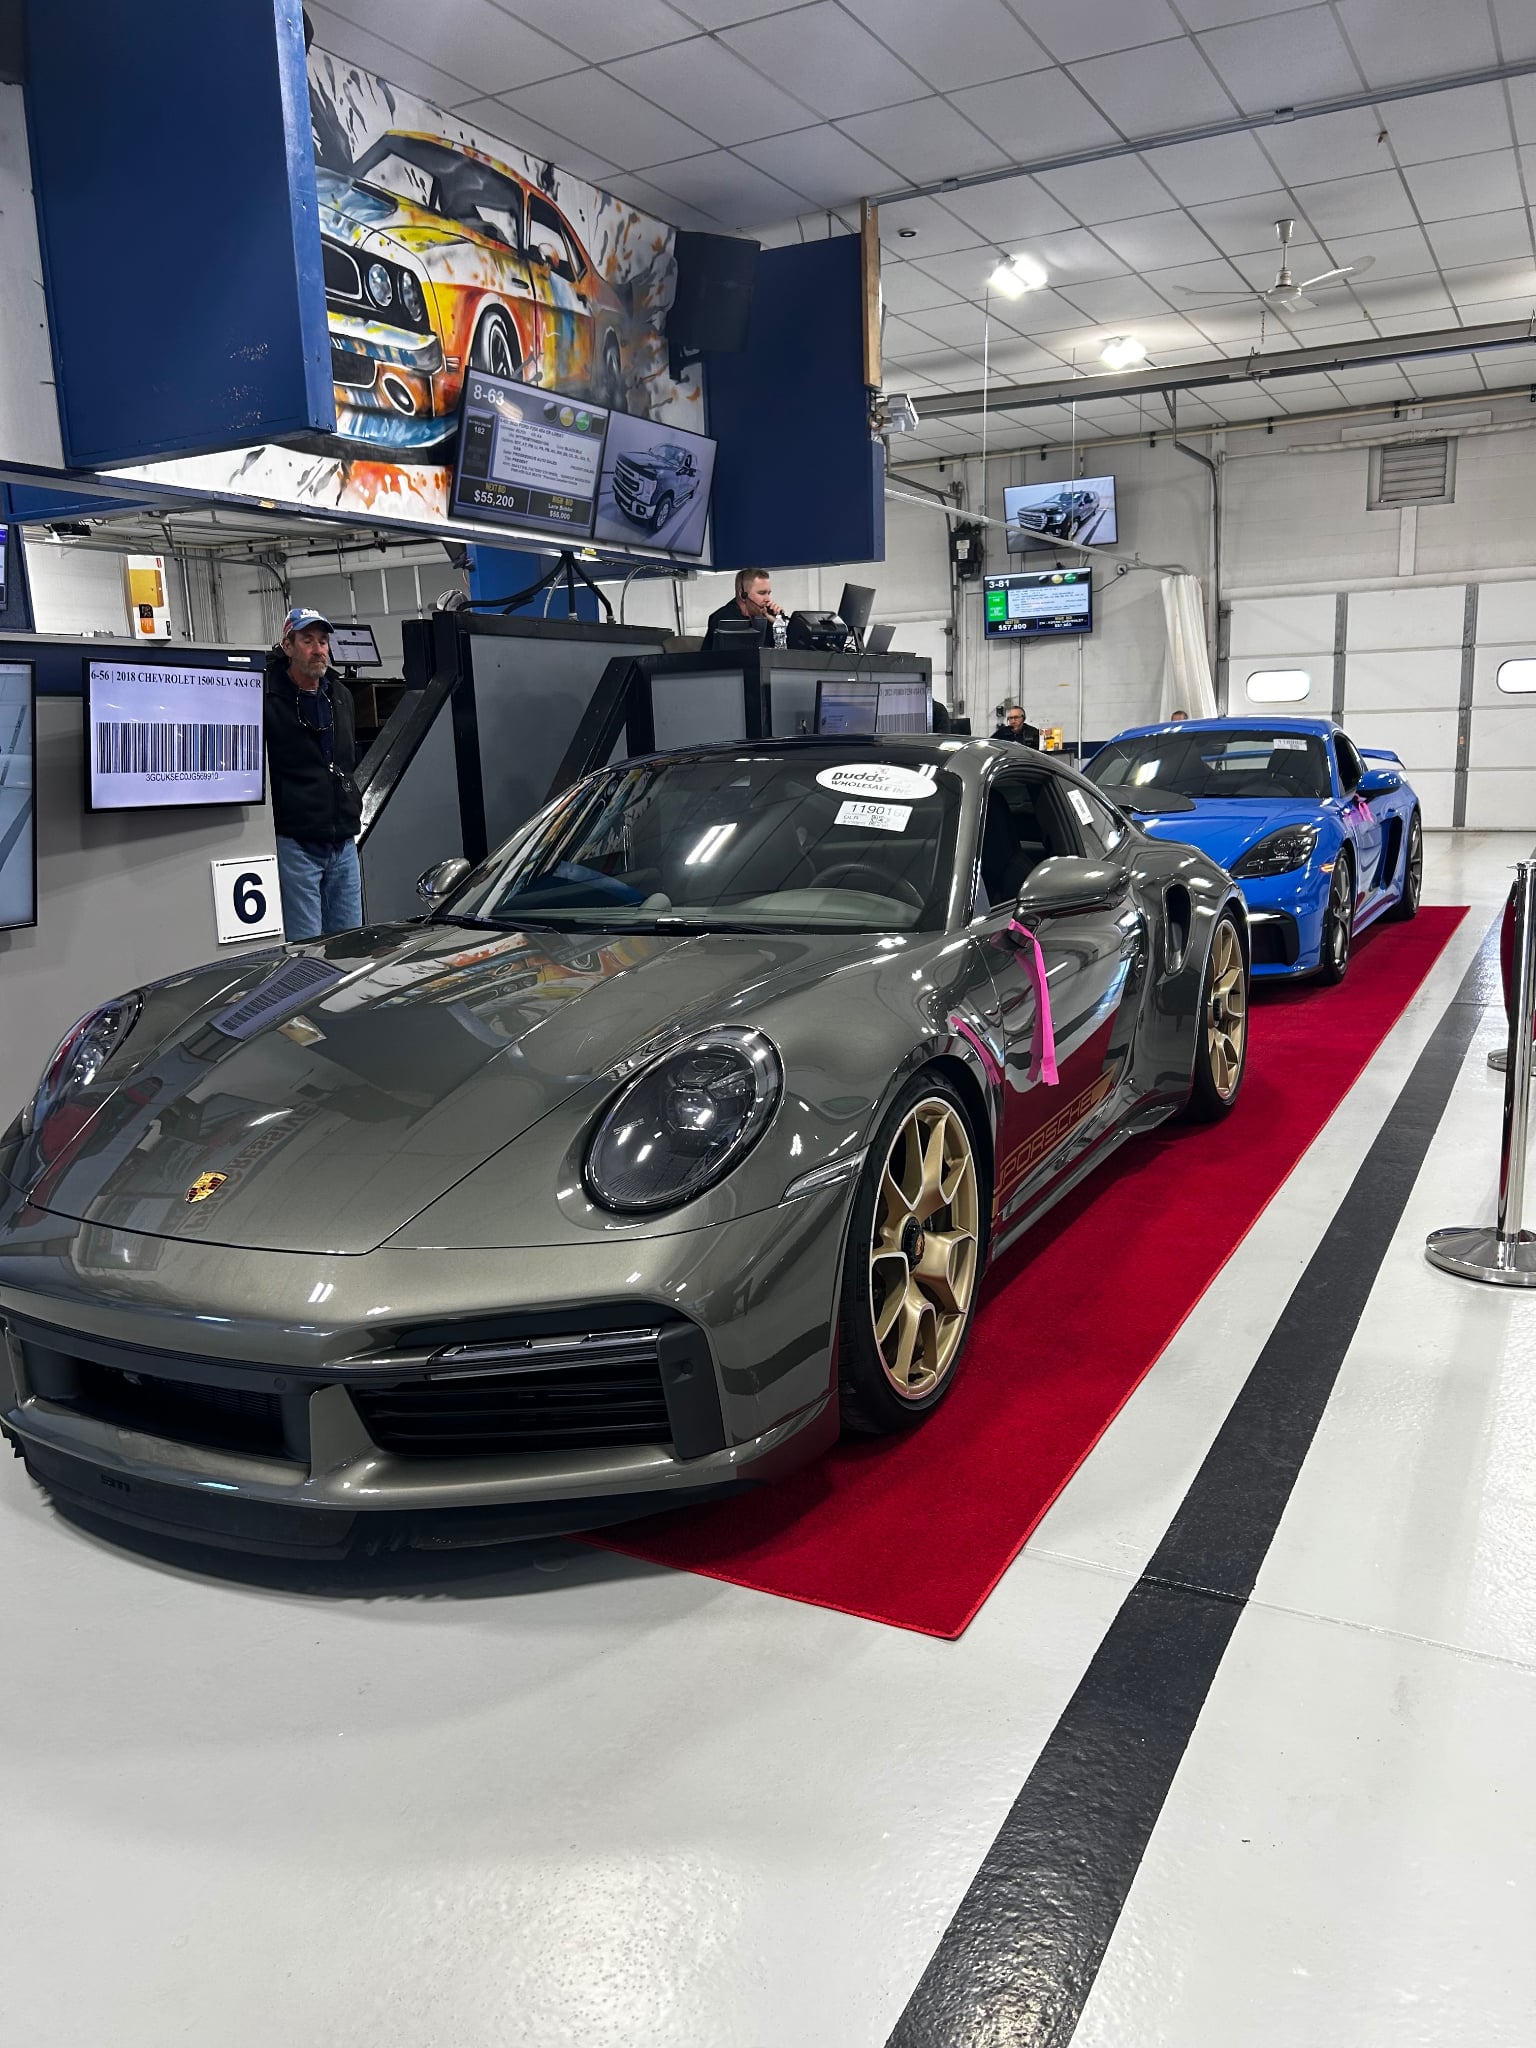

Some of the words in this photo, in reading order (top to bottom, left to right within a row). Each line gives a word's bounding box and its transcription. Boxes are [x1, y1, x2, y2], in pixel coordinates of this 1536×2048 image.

[473, 384, 505, 406] 8-63
[473, 489, 515, 508] $55,200
[549, 510, 571, 520] $55,000
[988, 579, 1010, 589] 3-81
[998, 623, 1027, 632] $57,800
[91, 670, 110, 681] 6-56
[116, 671, 136, 682] 2018
[137, 672, 196, 685] CHEVROLET
[198, 675, 215, 686] 1500
[216, 675, 233, 687] SLV
[233, 677, 249, 688] 4X4
[249, 678, 262, 689] CR
[831, 780, 892, 792] WHOLESALE
[232, 872, 267, 925] 6
[1001, 1088, 1095, 1185] PORSCHE
